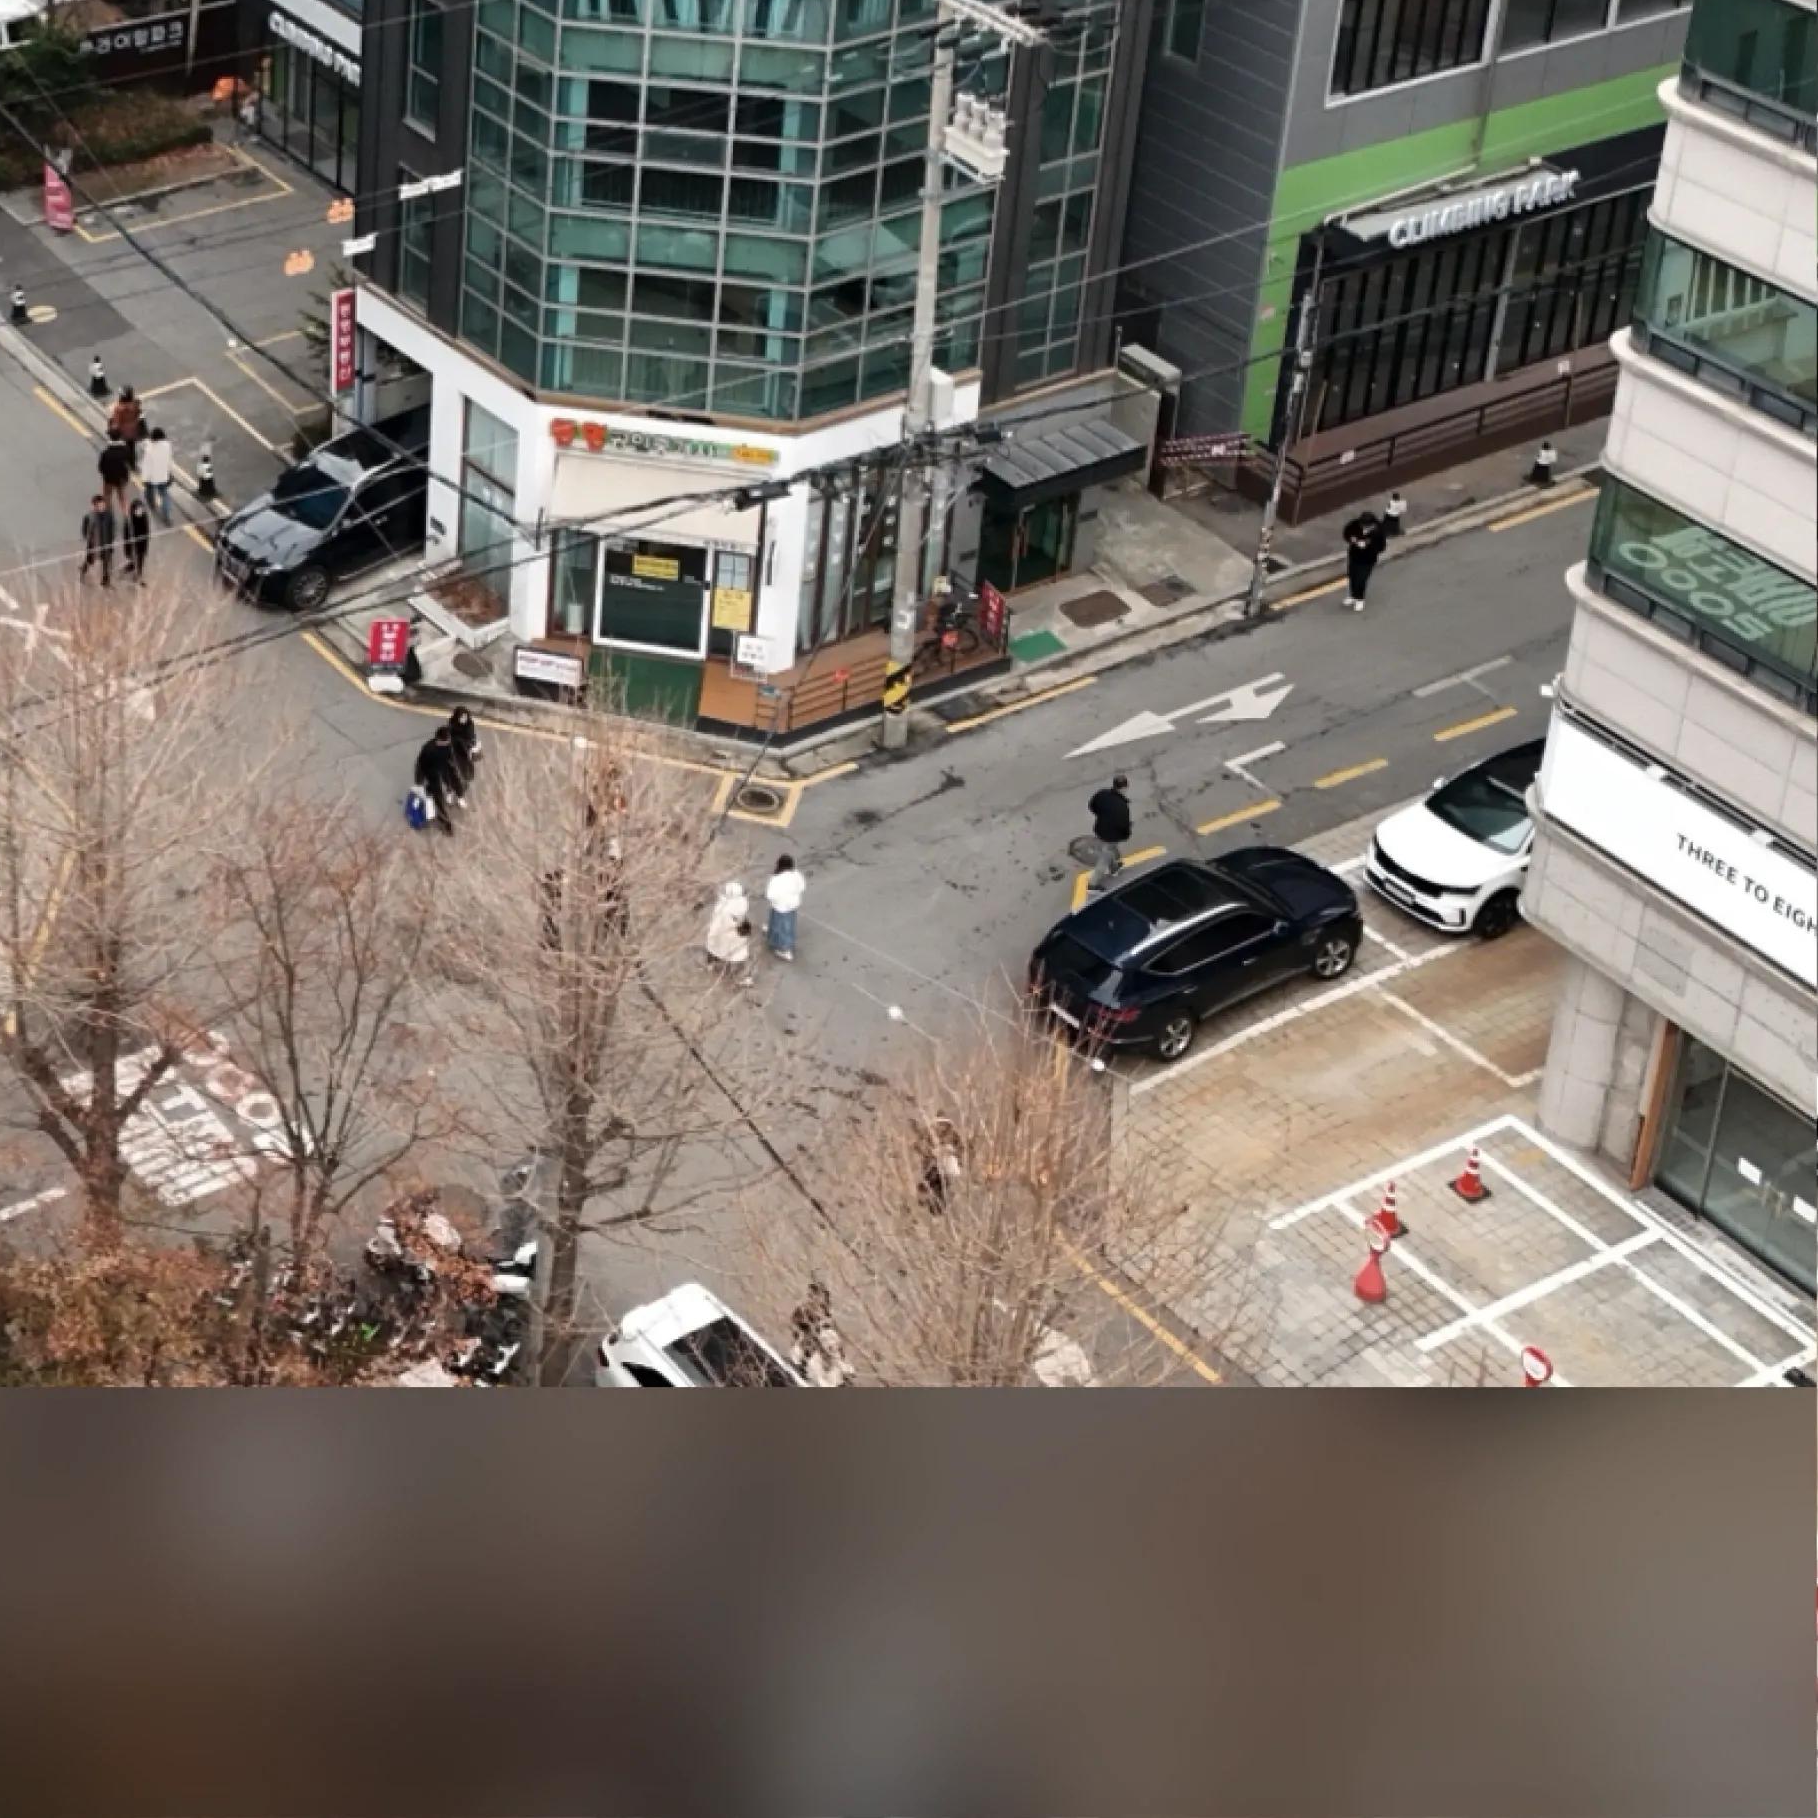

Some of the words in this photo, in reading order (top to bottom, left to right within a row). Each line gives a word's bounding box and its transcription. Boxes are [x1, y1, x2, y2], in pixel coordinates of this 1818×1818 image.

[1389, 189, 1510, 249] CLIMBING
[1513, 168, 1580, 215] PARK
[1677, 833, 1739, 885] THREE
[1743, 875, 1770, 904] TO
